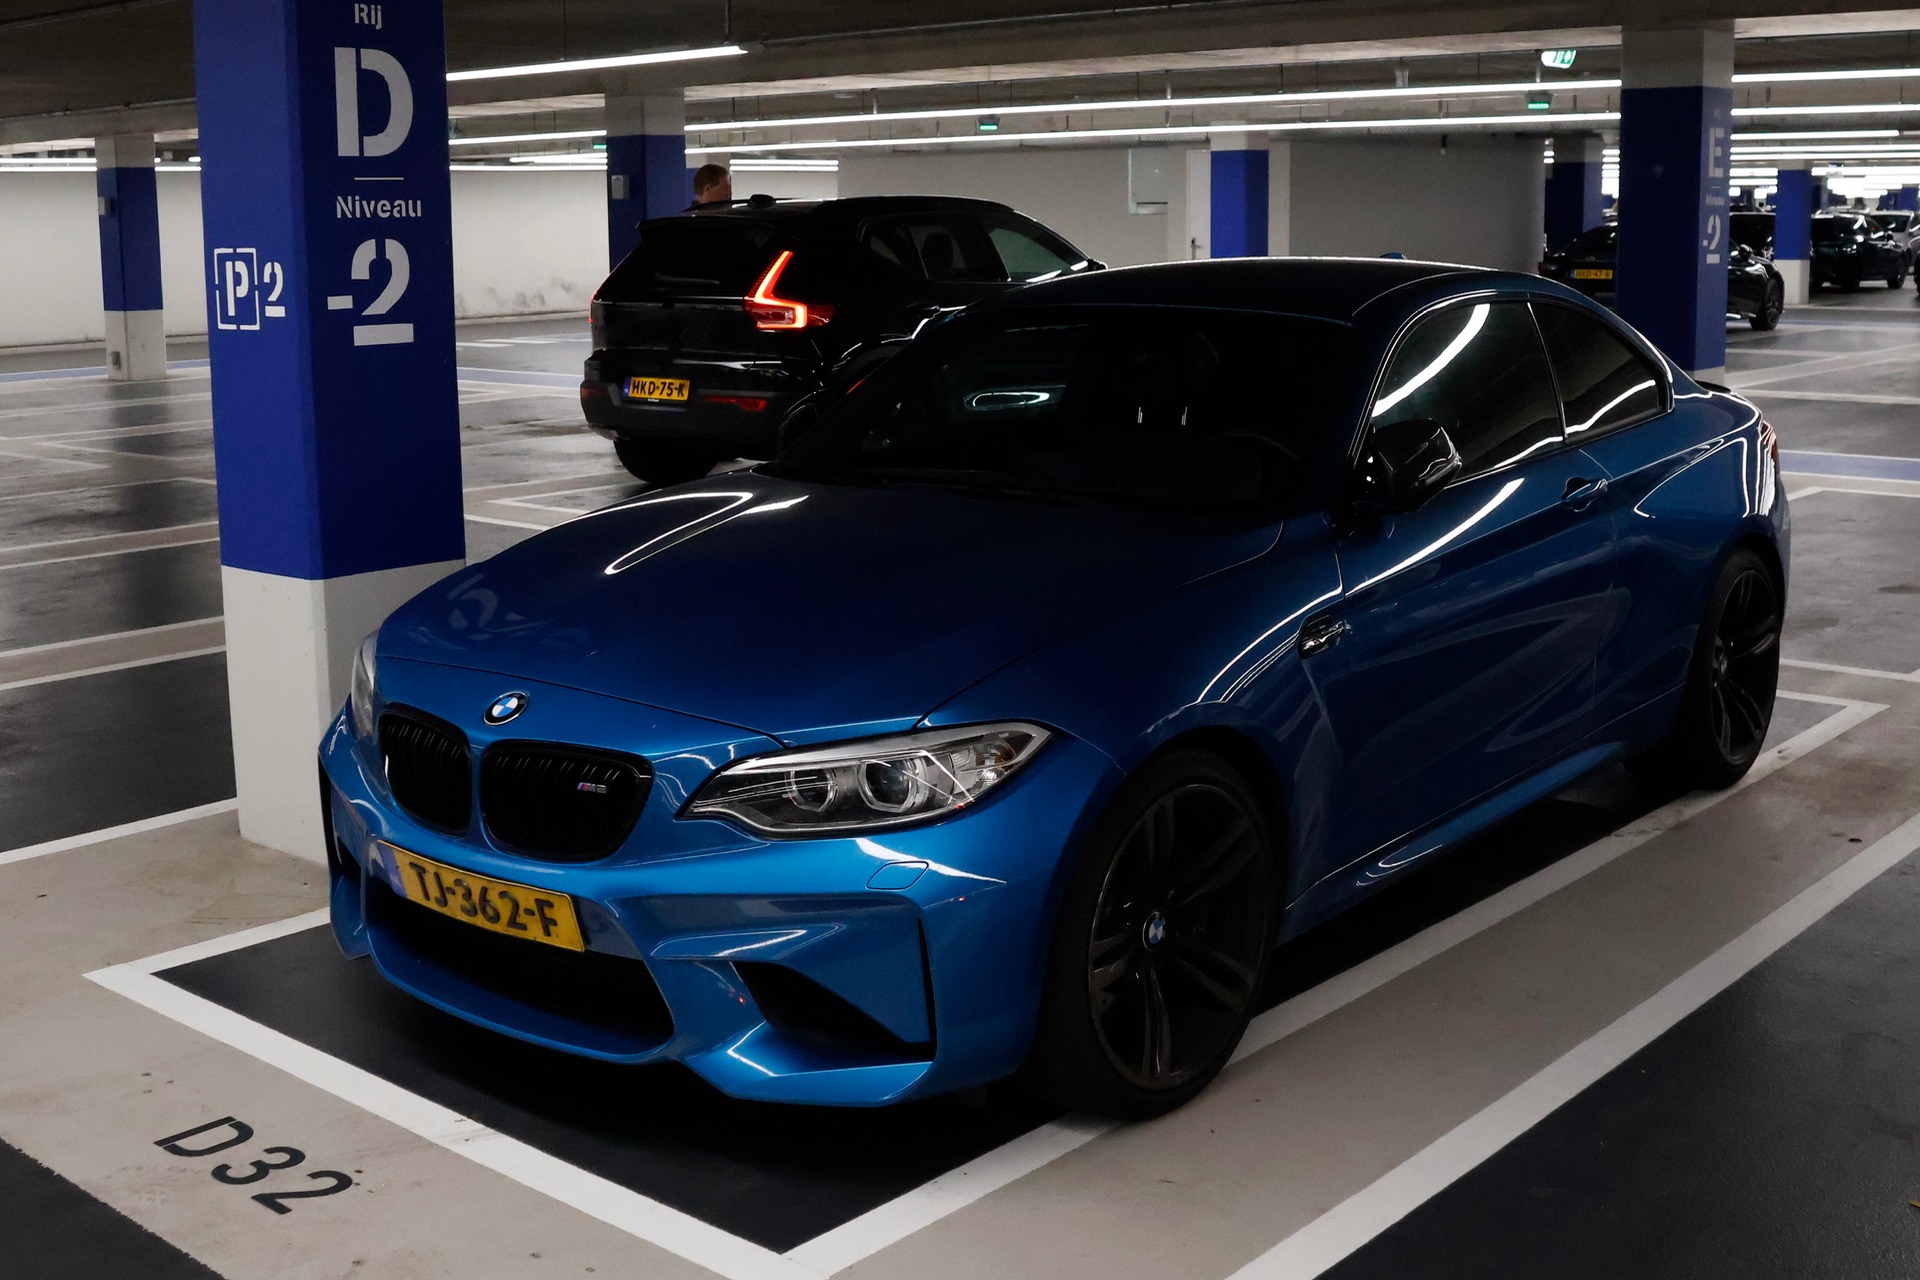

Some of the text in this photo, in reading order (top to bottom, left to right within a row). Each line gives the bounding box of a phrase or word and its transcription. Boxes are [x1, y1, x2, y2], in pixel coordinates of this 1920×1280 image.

[354, 2, 383, 30] Rij
[334, 47, 414, 157] D
[1708, 127, 1725, 178] E
[336, 195, 422, 219] Niveau
[1702, 214, 1721, 265] -2
[327, 238, 415, 346] -2
[631, 380, 685, 398] HKD-75-K
[408, 861, 559, 938] TJ-362-F
[152, 1115, 354, 1216] D32
